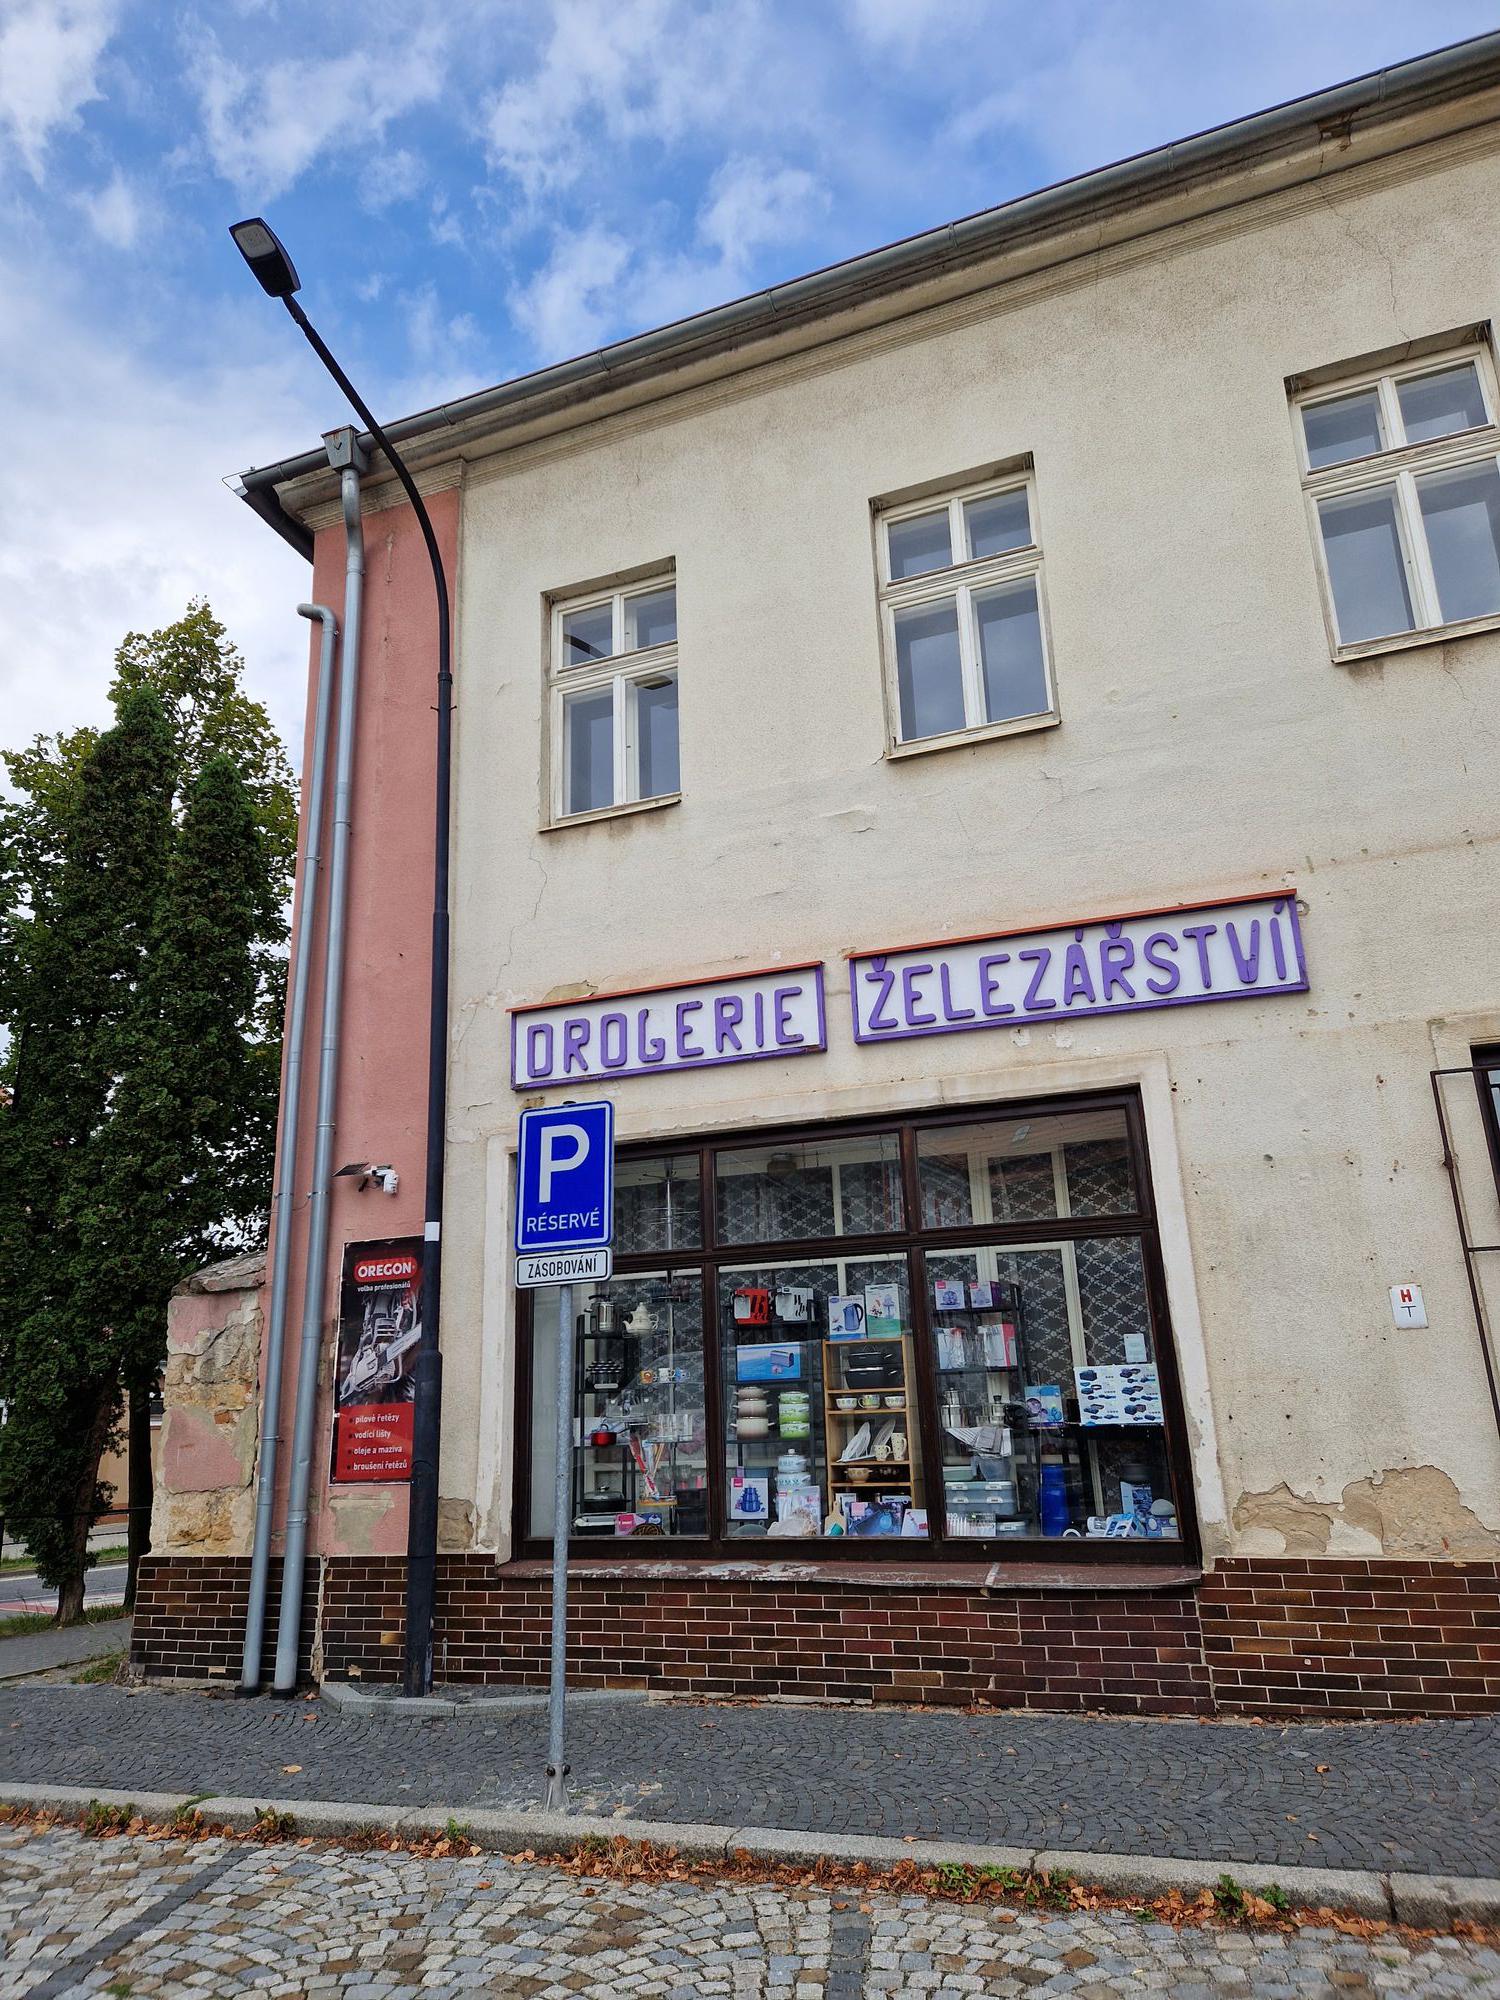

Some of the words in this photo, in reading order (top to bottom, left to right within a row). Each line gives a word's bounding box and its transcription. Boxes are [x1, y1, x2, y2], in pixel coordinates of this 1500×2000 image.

[864, 899, 1288, 1030] ŽELEZÁŘSTVÍ
[526, 985, 804, 1078] DROGERIE
[538, 1123, 590, 1204] P
[526, 1207, 600, 1233] RÉSERVÉ
[357, 1262, 412, 1278] OREGON
[528, 1253, 598, 1279] ZÁSOBOVÁNÍ
[1400, 1289, 1412, 1302] H
[377, 1413, 400, 1423] řetězy
[353, 1446, 372, 1456] oleje
[378, 1446, 403, 1454] maziva
